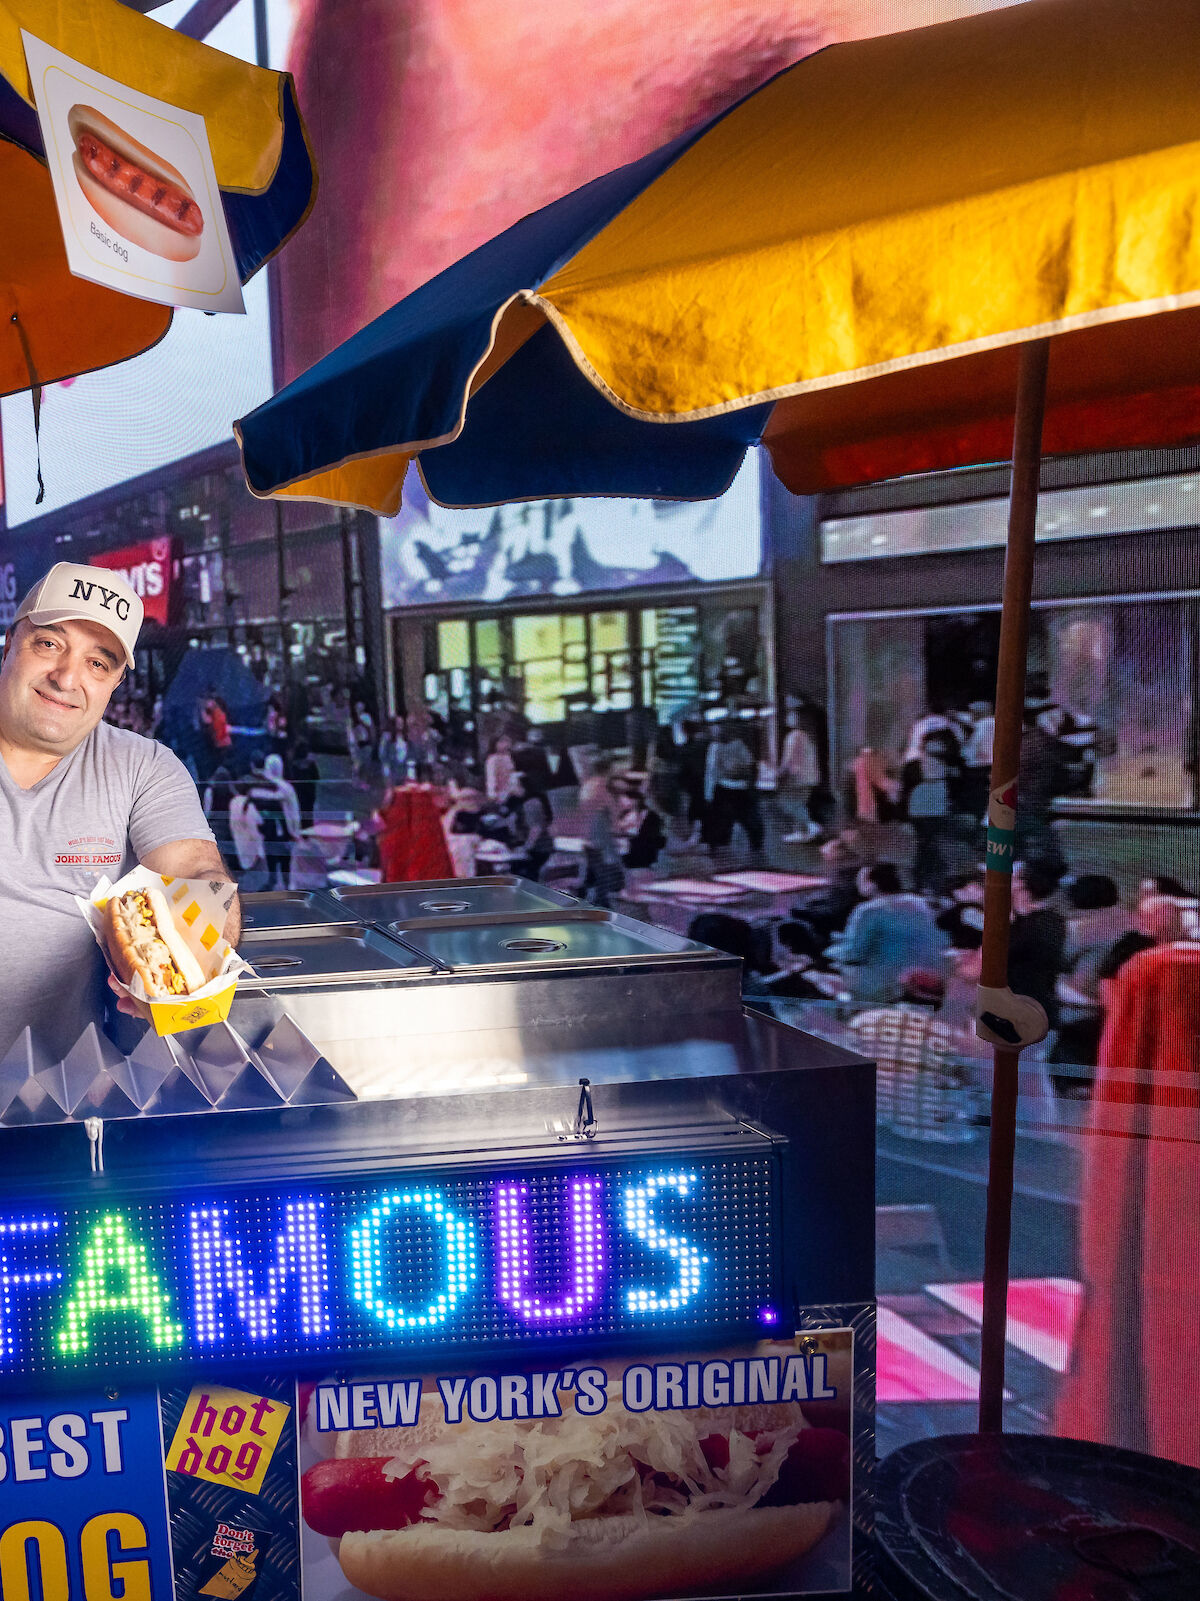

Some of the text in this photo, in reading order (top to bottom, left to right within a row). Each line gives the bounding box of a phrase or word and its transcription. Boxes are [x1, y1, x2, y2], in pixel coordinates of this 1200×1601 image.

[90, 221, 128, 262] Basic dog
[68, 579, 131, 620] NYC
[987, 840, 1007, 856] EW
[318, 1355, 834, 1430] NEW YORK'S ORIGINAL
[190, 1394, 276, 1437] hot
[176, 1436, 262, 1481] dog
[214, 1536, 255, 1552] forget
[216, 1524, 254, 1541] Don't
